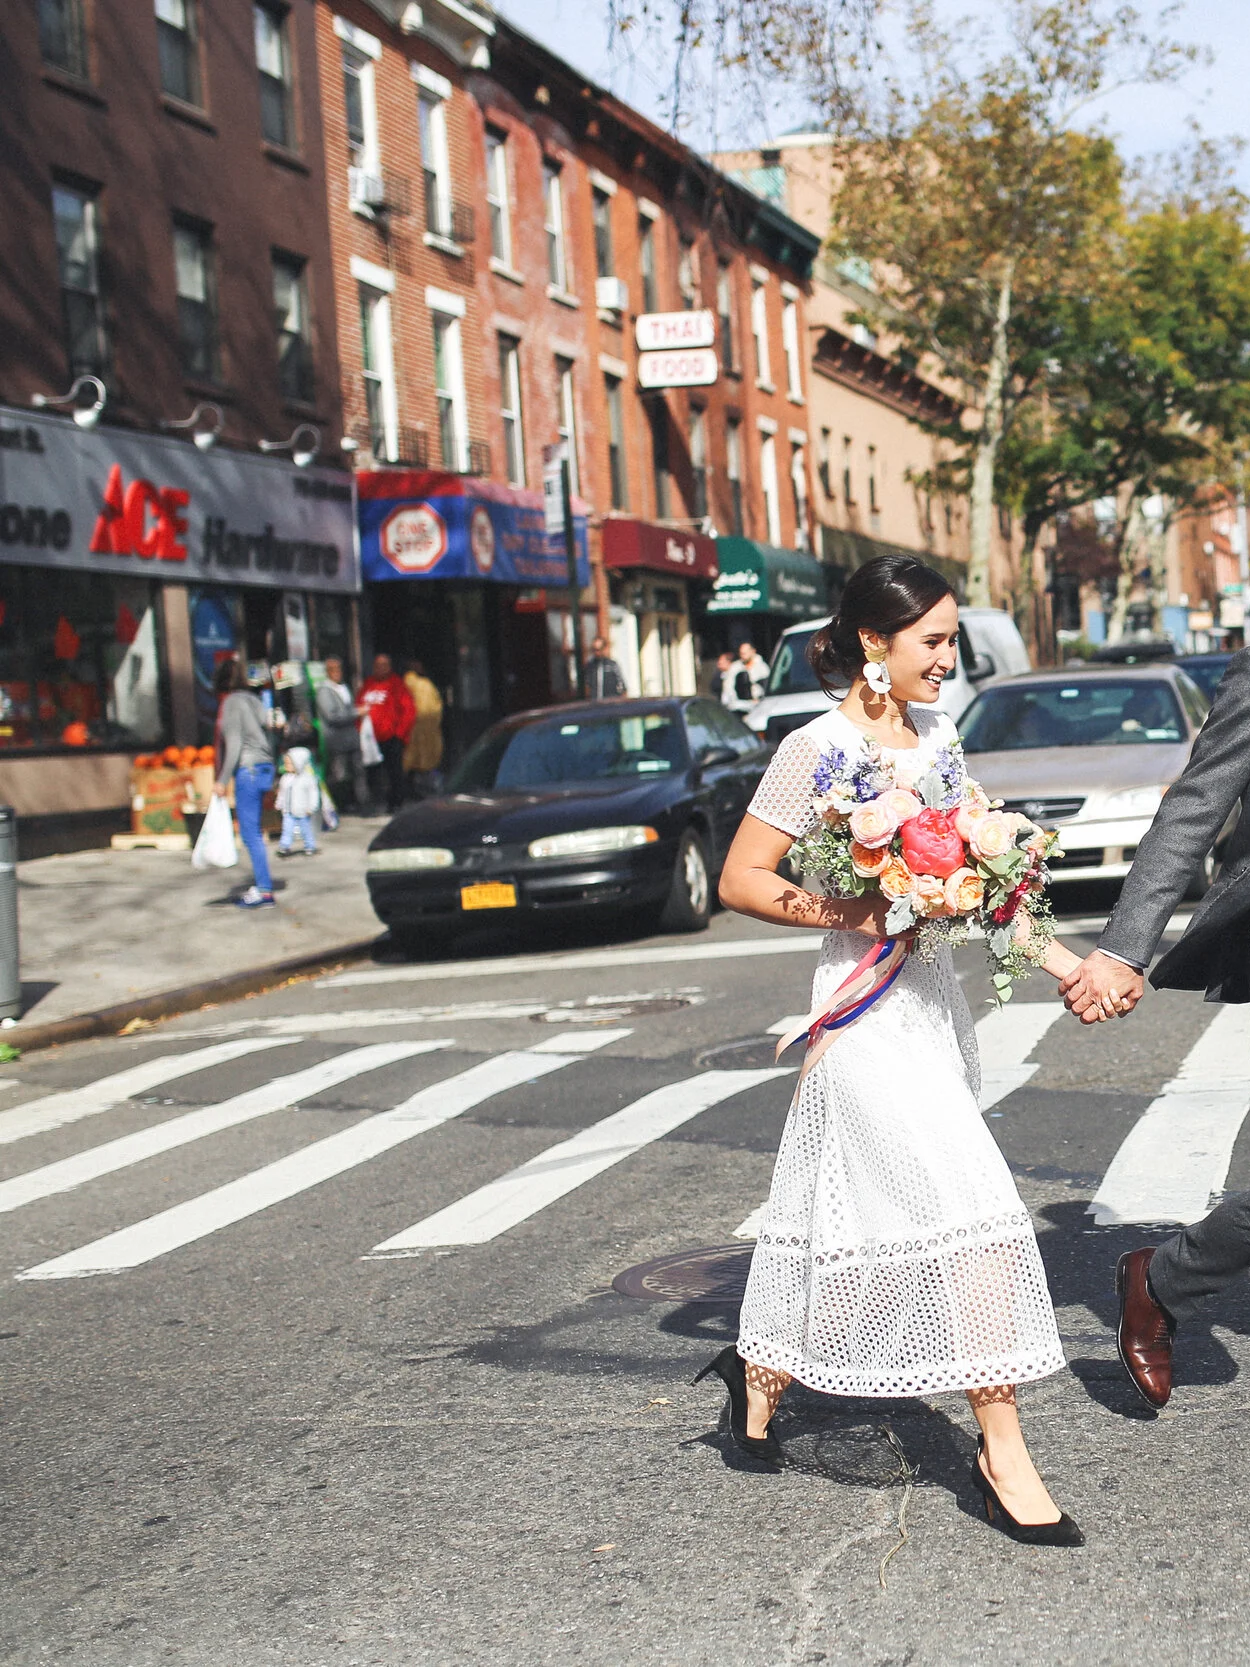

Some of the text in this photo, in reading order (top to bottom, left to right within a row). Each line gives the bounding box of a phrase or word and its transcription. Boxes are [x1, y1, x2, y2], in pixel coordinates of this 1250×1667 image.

[650, 318, 702, 341] THAI
[651, 355, 706, 378] FOOD
[89, 462, 190, 561] ACE
[203, 516, 340, 579] Hardware
